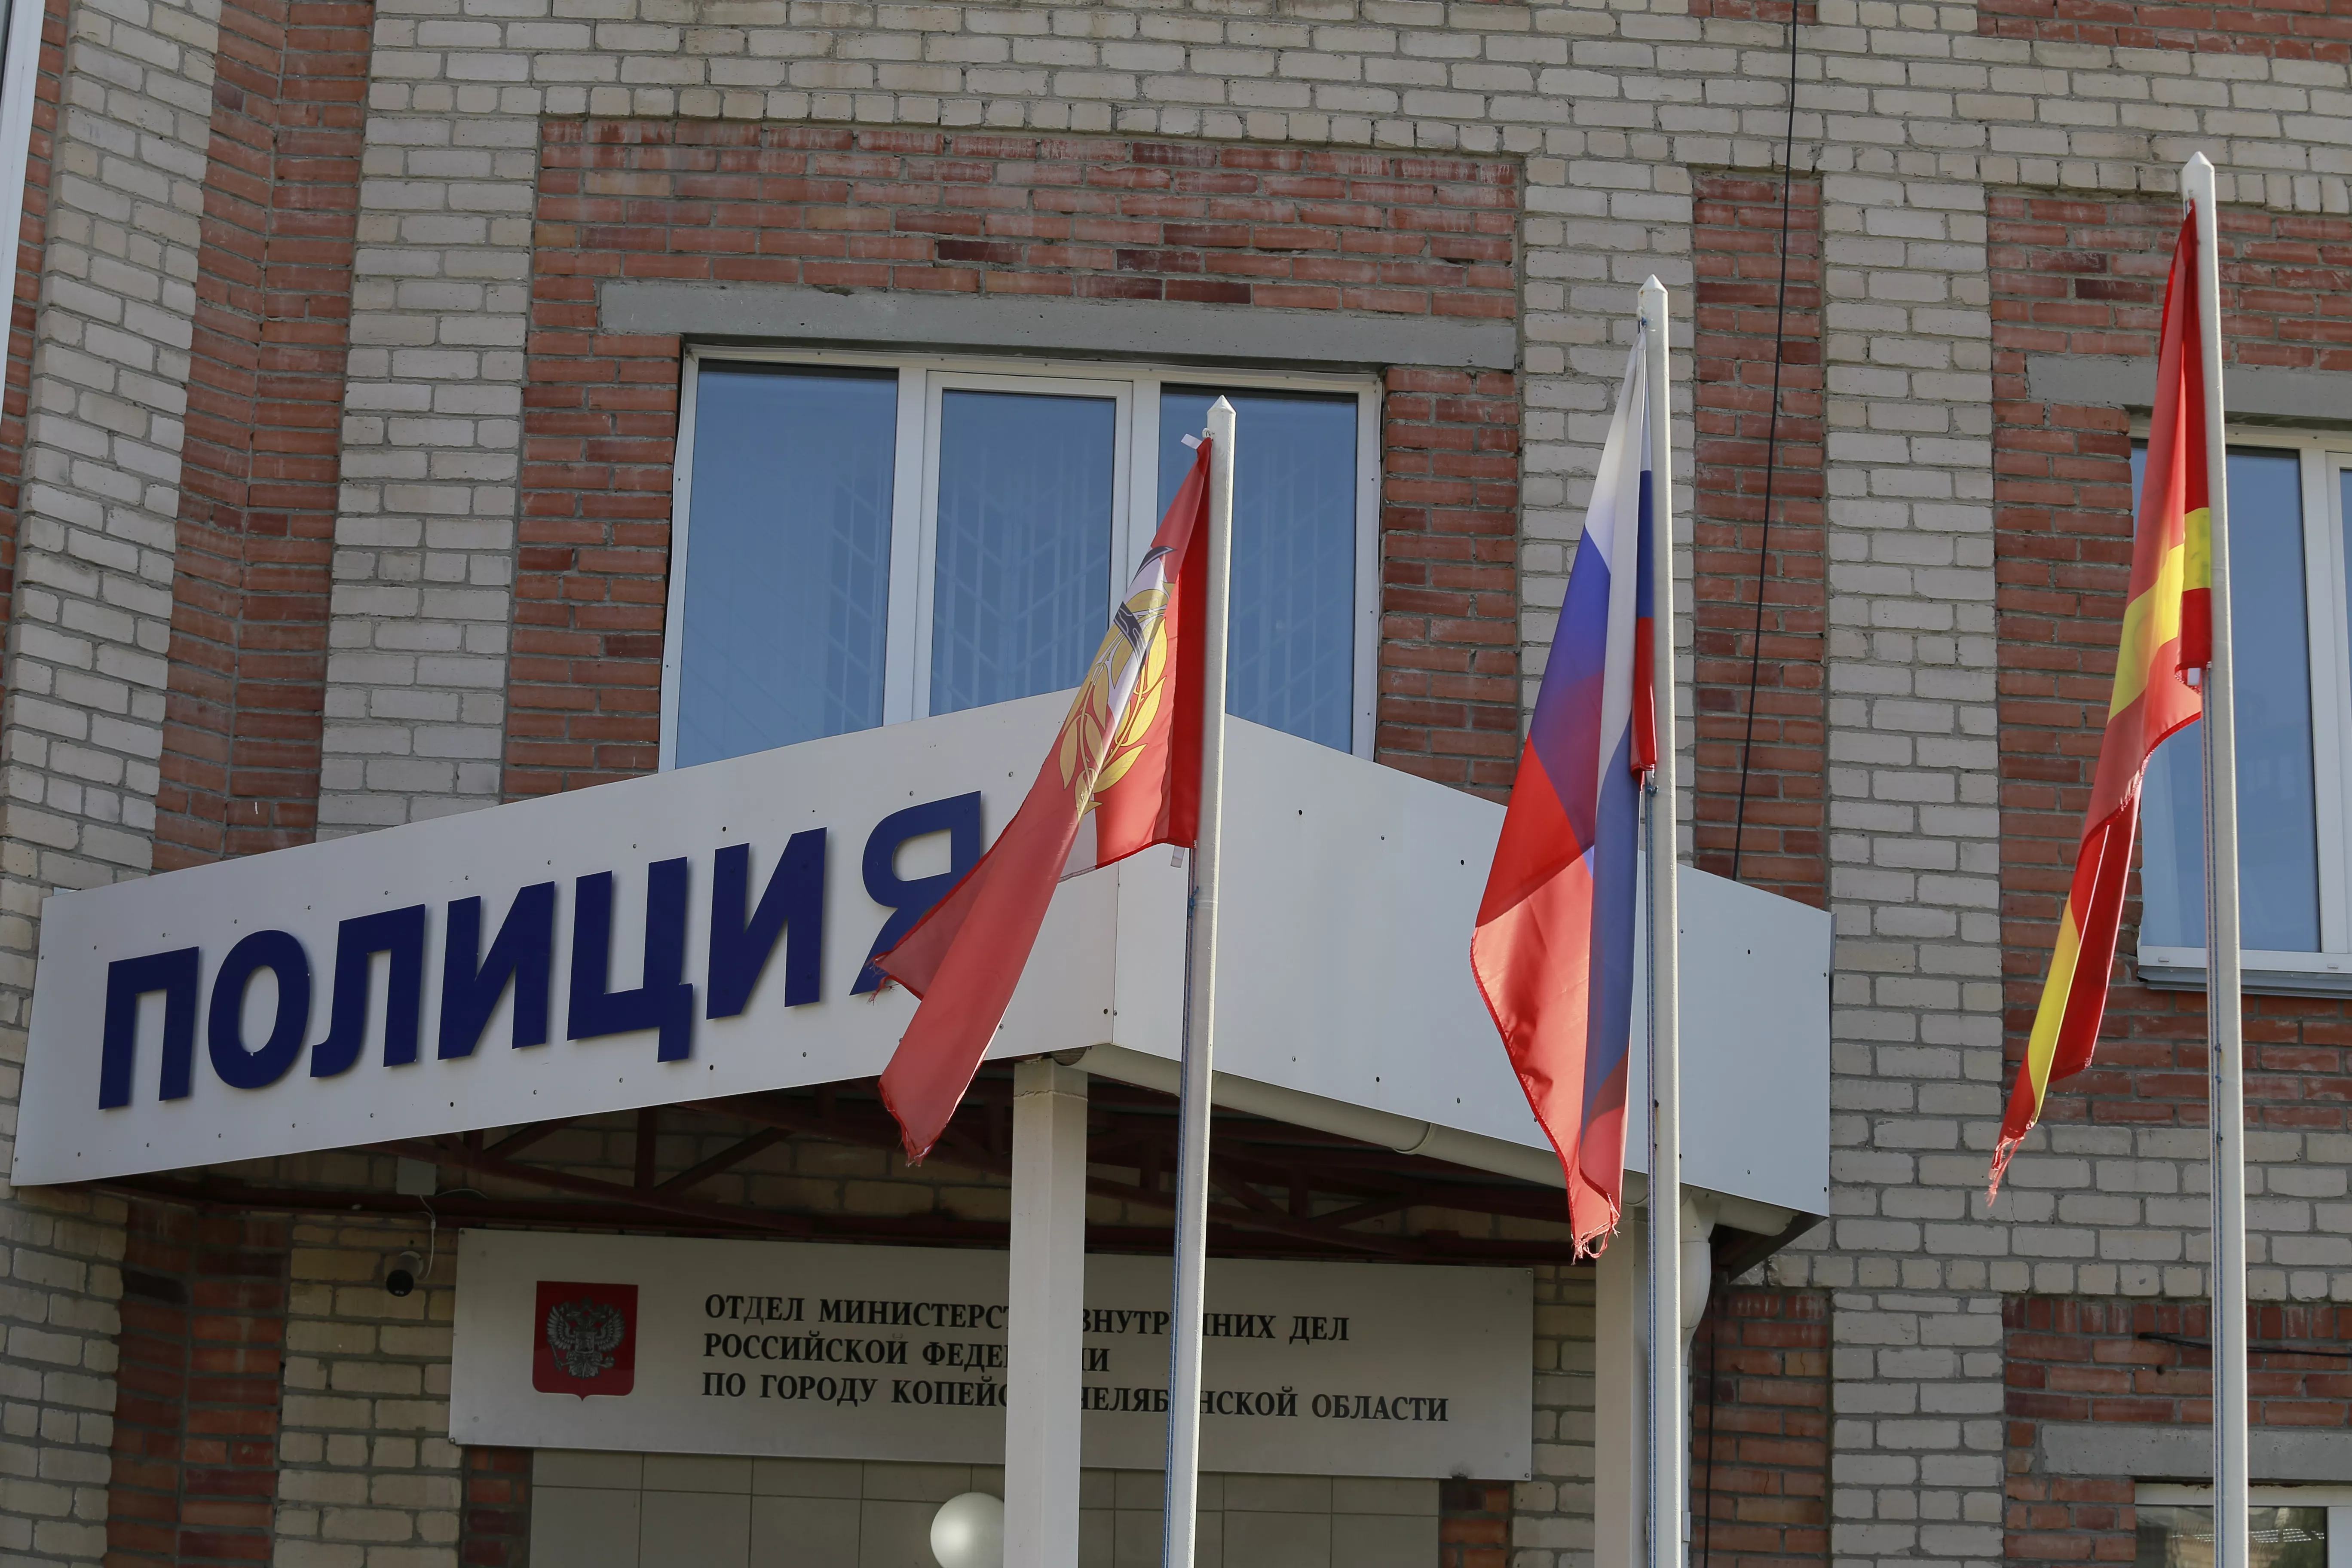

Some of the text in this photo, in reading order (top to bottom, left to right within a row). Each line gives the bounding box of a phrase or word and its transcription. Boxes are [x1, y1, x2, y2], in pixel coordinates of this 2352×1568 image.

[98, 790, 982, 1110] ПОЛИЦИЯ
[704, 1293, 1350, 1345] ОТДЕЛ МИНИСТЕРС НУТРНИХ ДЕЛ
[703, 1329, 1111, 1373] РОССИЙСКОЙ ФЕДЕИ
[701, 1372, 746, 1397] ПО
[759, 1374, 878, 1407] ГОРОДУ
[1080, 1385, 1298, 1417] ЕЛЯБНСКОЙ
[1311, 1393, 1449, 1422] ОБЛАСТИ
